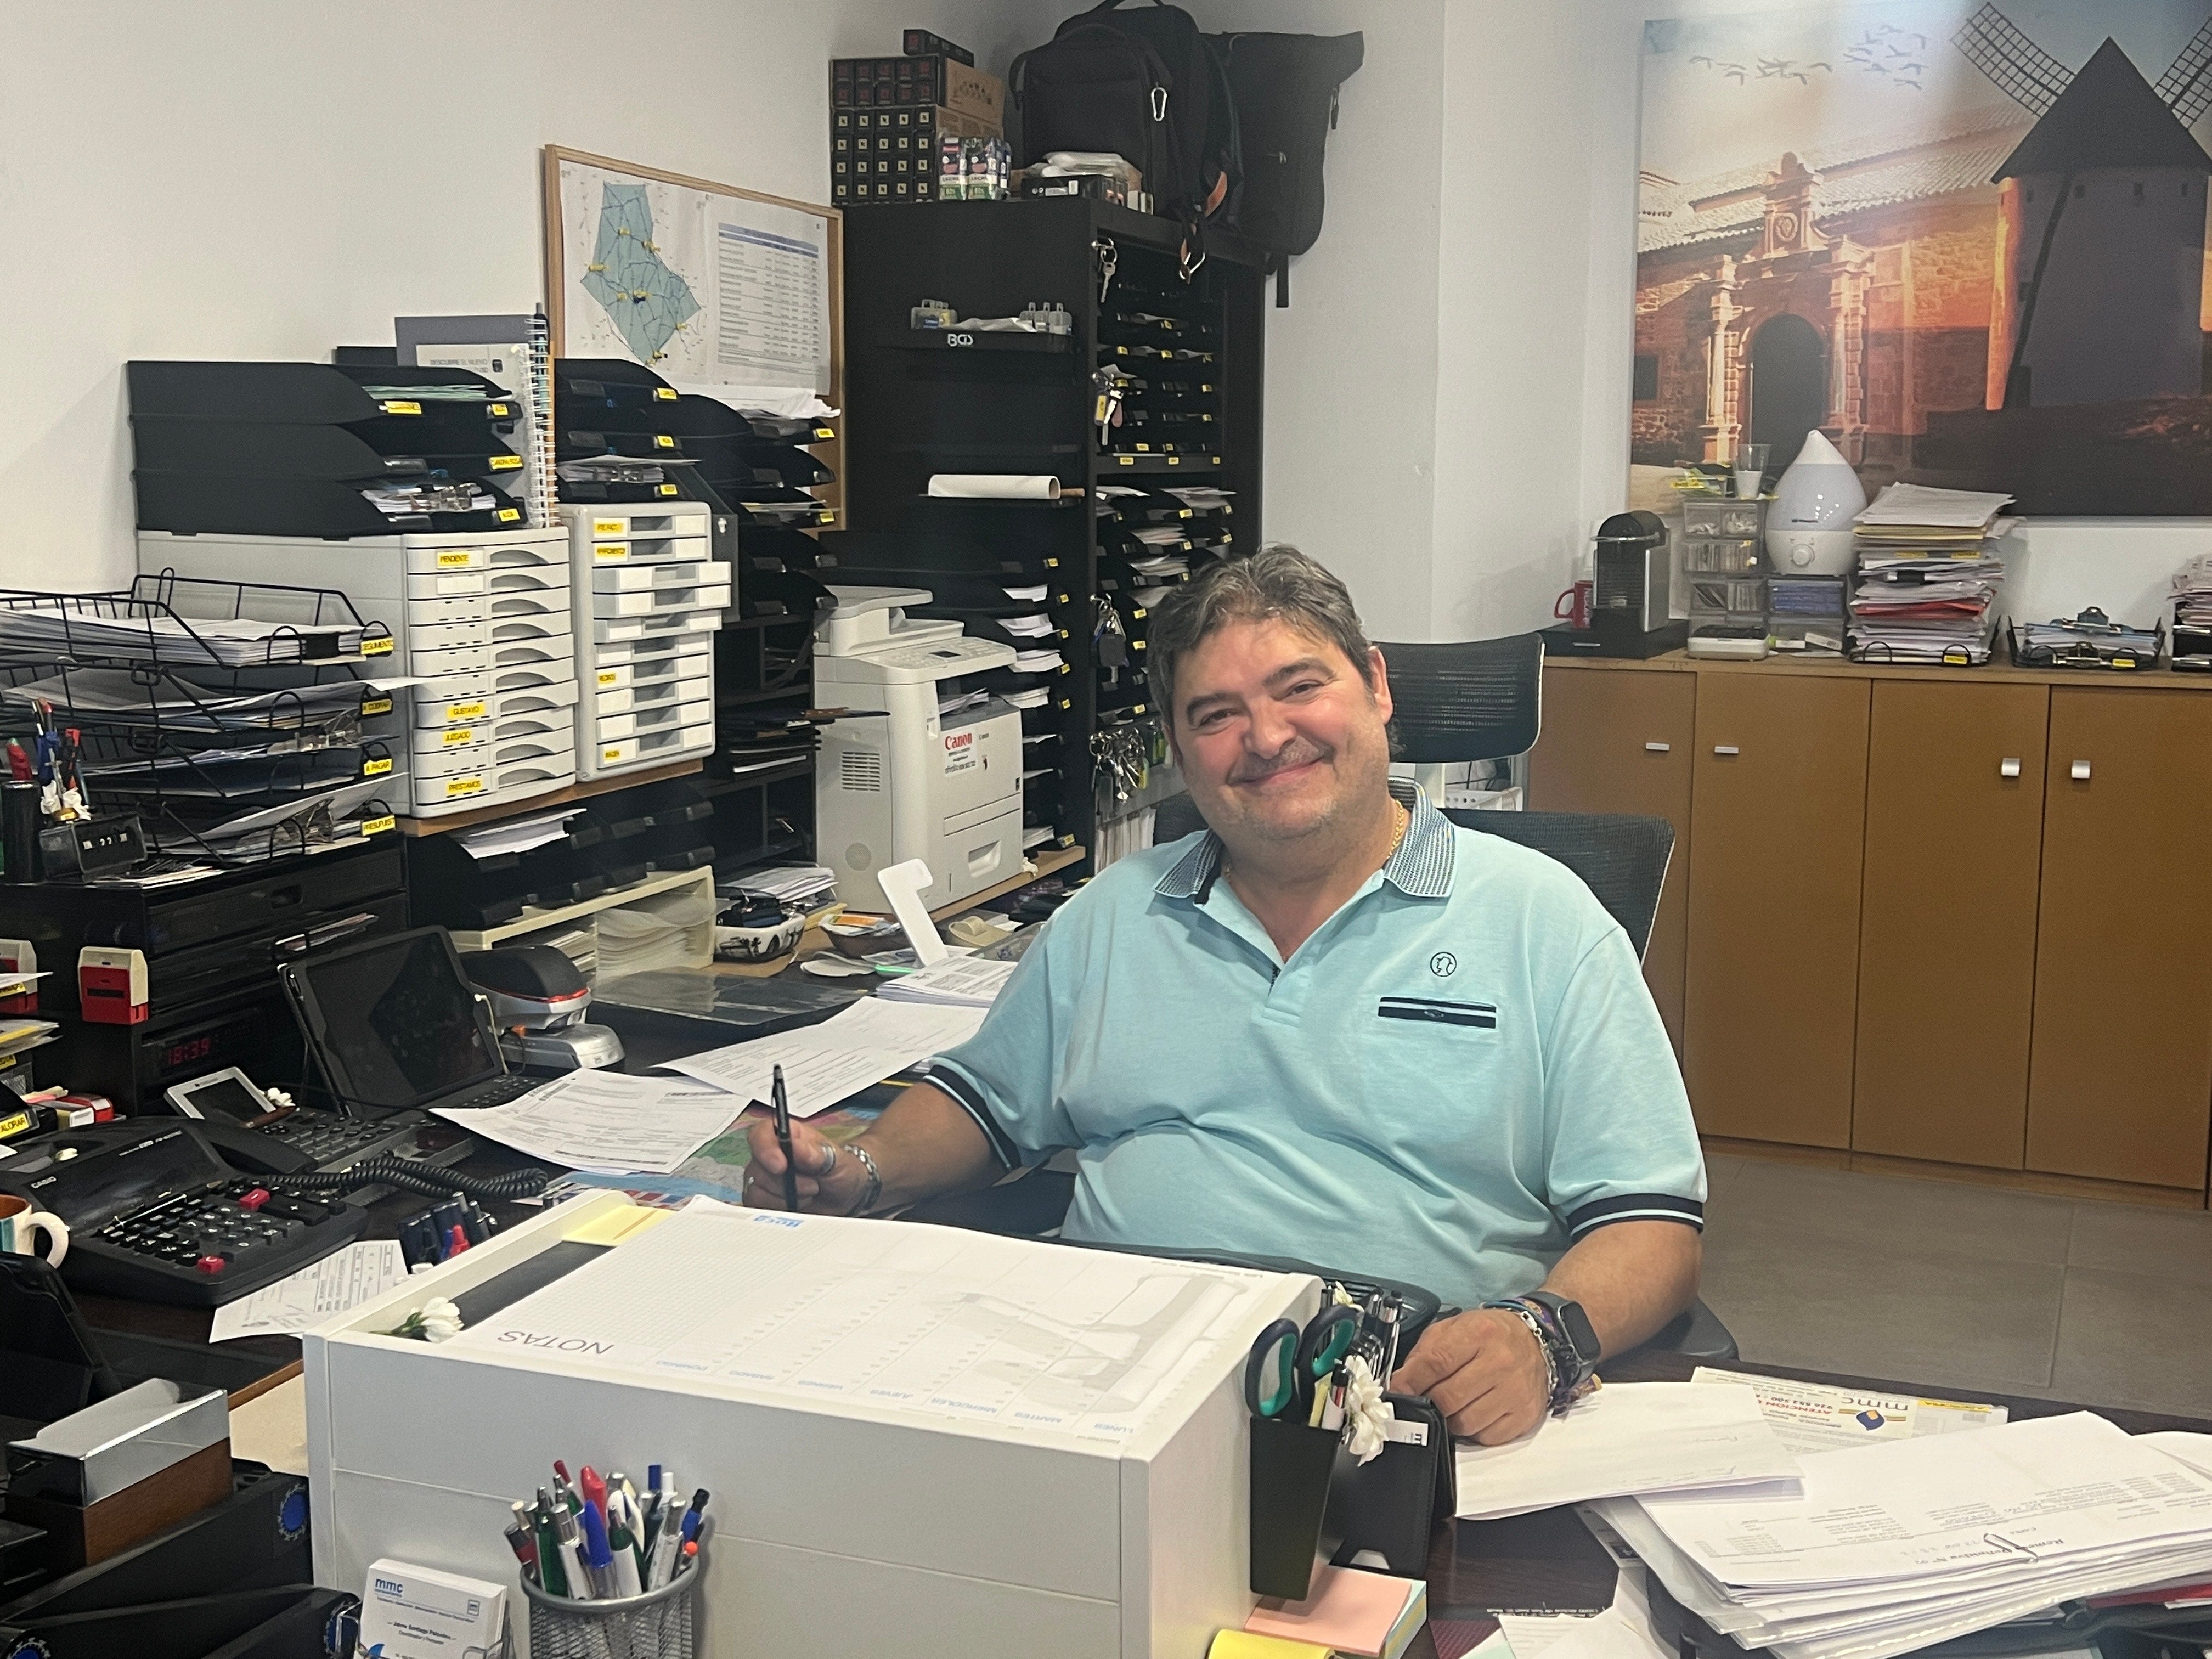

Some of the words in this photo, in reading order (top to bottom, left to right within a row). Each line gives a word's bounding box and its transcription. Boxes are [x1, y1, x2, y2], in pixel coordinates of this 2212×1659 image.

[453, 706, 480, 715] GUSTAVO
[945, 733, 973, 751] Canon
[498, 1330, 615, 1355] NOTAS
[1841, 1397, 1908, 1410] mmc
[375, 1578, 403, 1593] mmc
